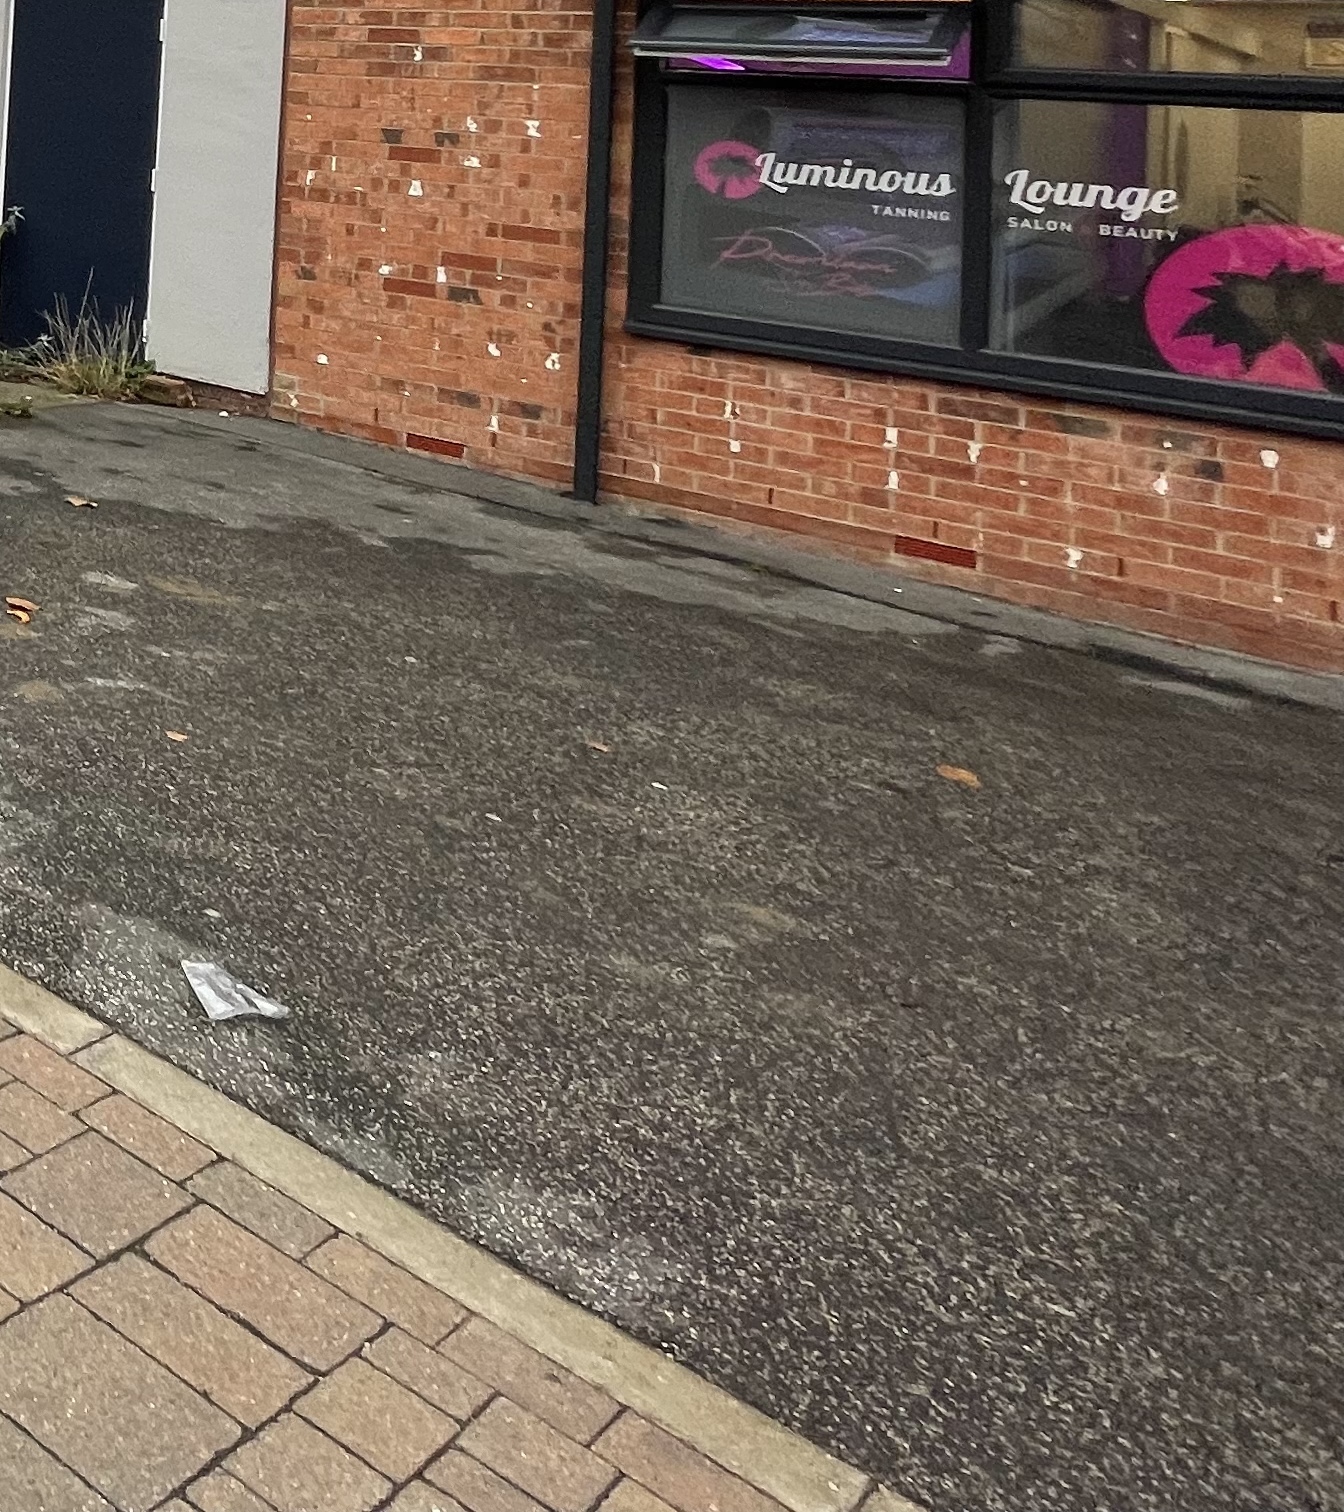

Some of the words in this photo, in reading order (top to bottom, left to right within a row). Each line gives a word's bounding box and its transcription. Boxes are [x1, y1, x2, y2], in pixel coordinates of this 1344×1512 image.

[755, 152, 957, 197] Luminous
[1004, 169, 1179, 222] Lounge
[872, 204, 951, 221] TANNING
[1007, 216, 1073, 233] SALON
[1099, 224, 1179, 242] BEAUTY
